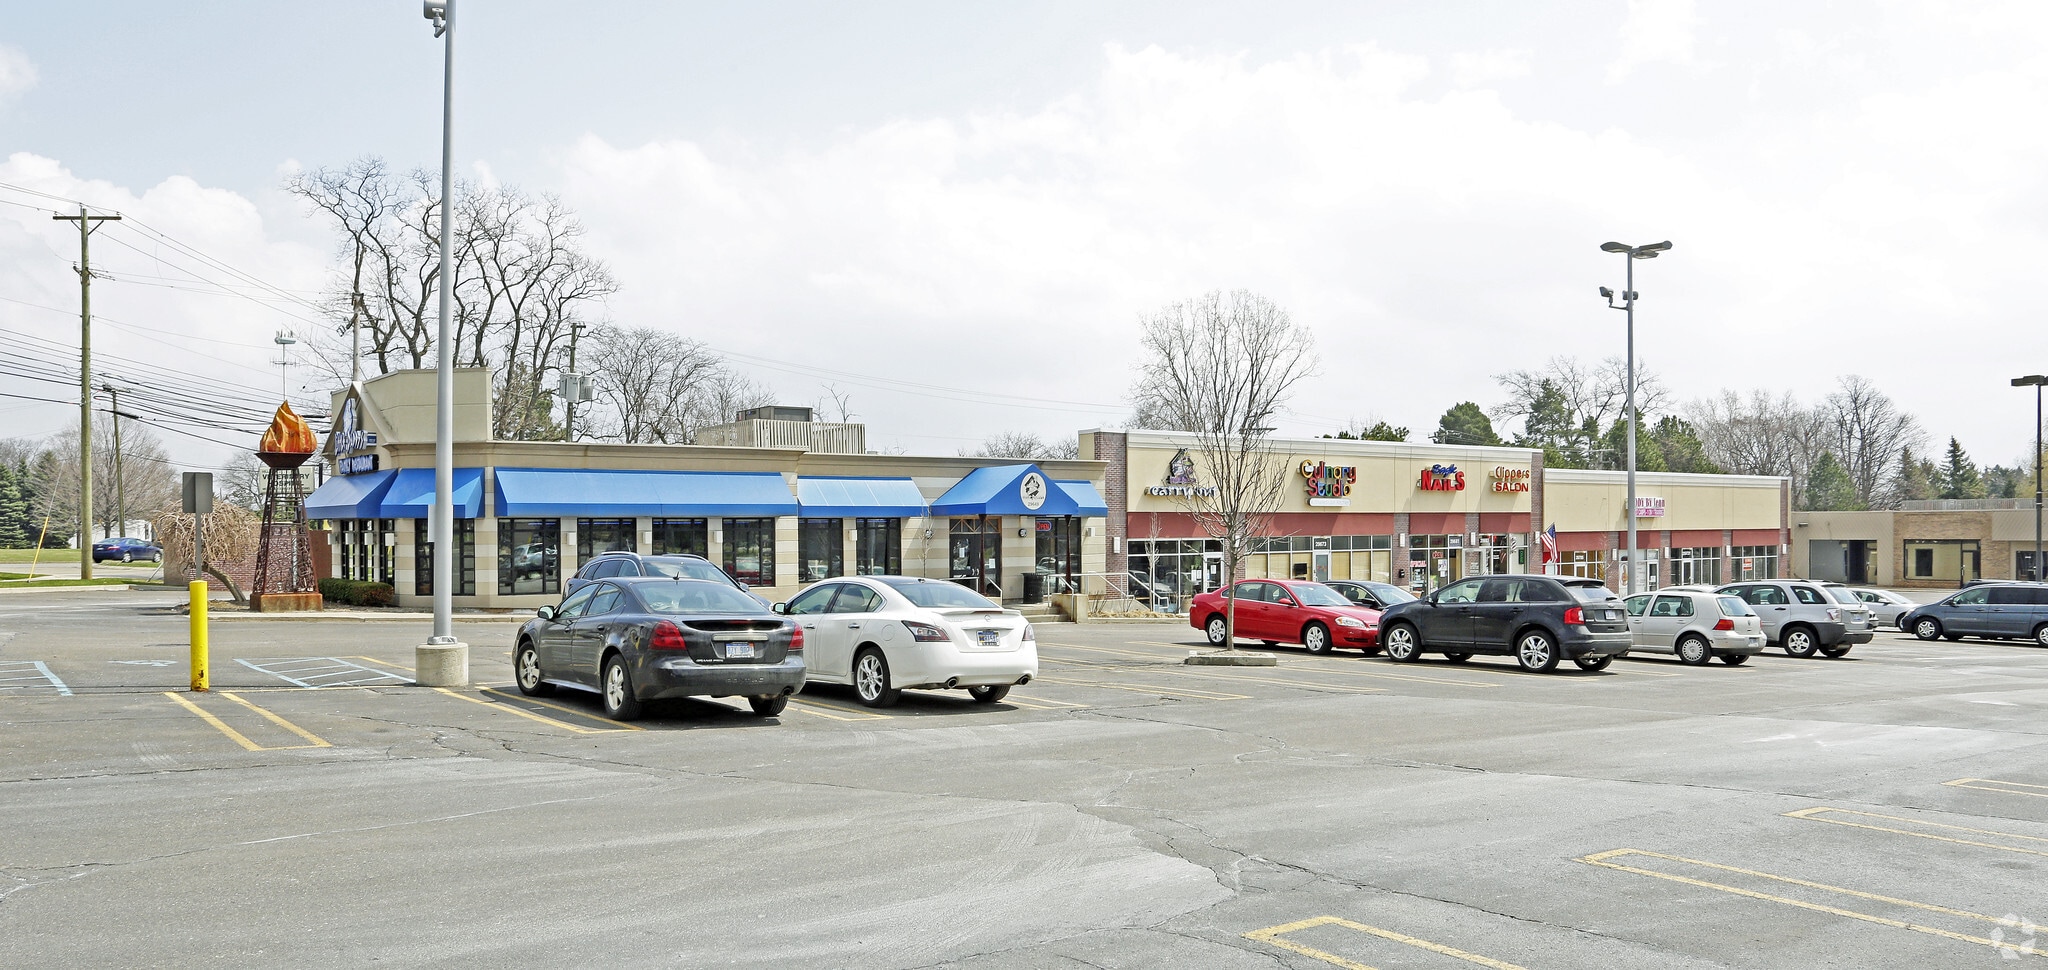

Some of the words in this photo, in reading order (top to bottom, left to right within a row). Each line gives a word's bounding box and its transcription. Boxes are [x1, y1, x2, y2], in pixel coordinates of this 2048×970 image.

[1300, 459, 1357, 485] Culinary
[1421, 470, 1466, 491] NAILS
[1495, 466, 1530, 482] Clippers
[1306, 477, 1352, 497] Studio
[1495, 482, 1529, 492] SALON
